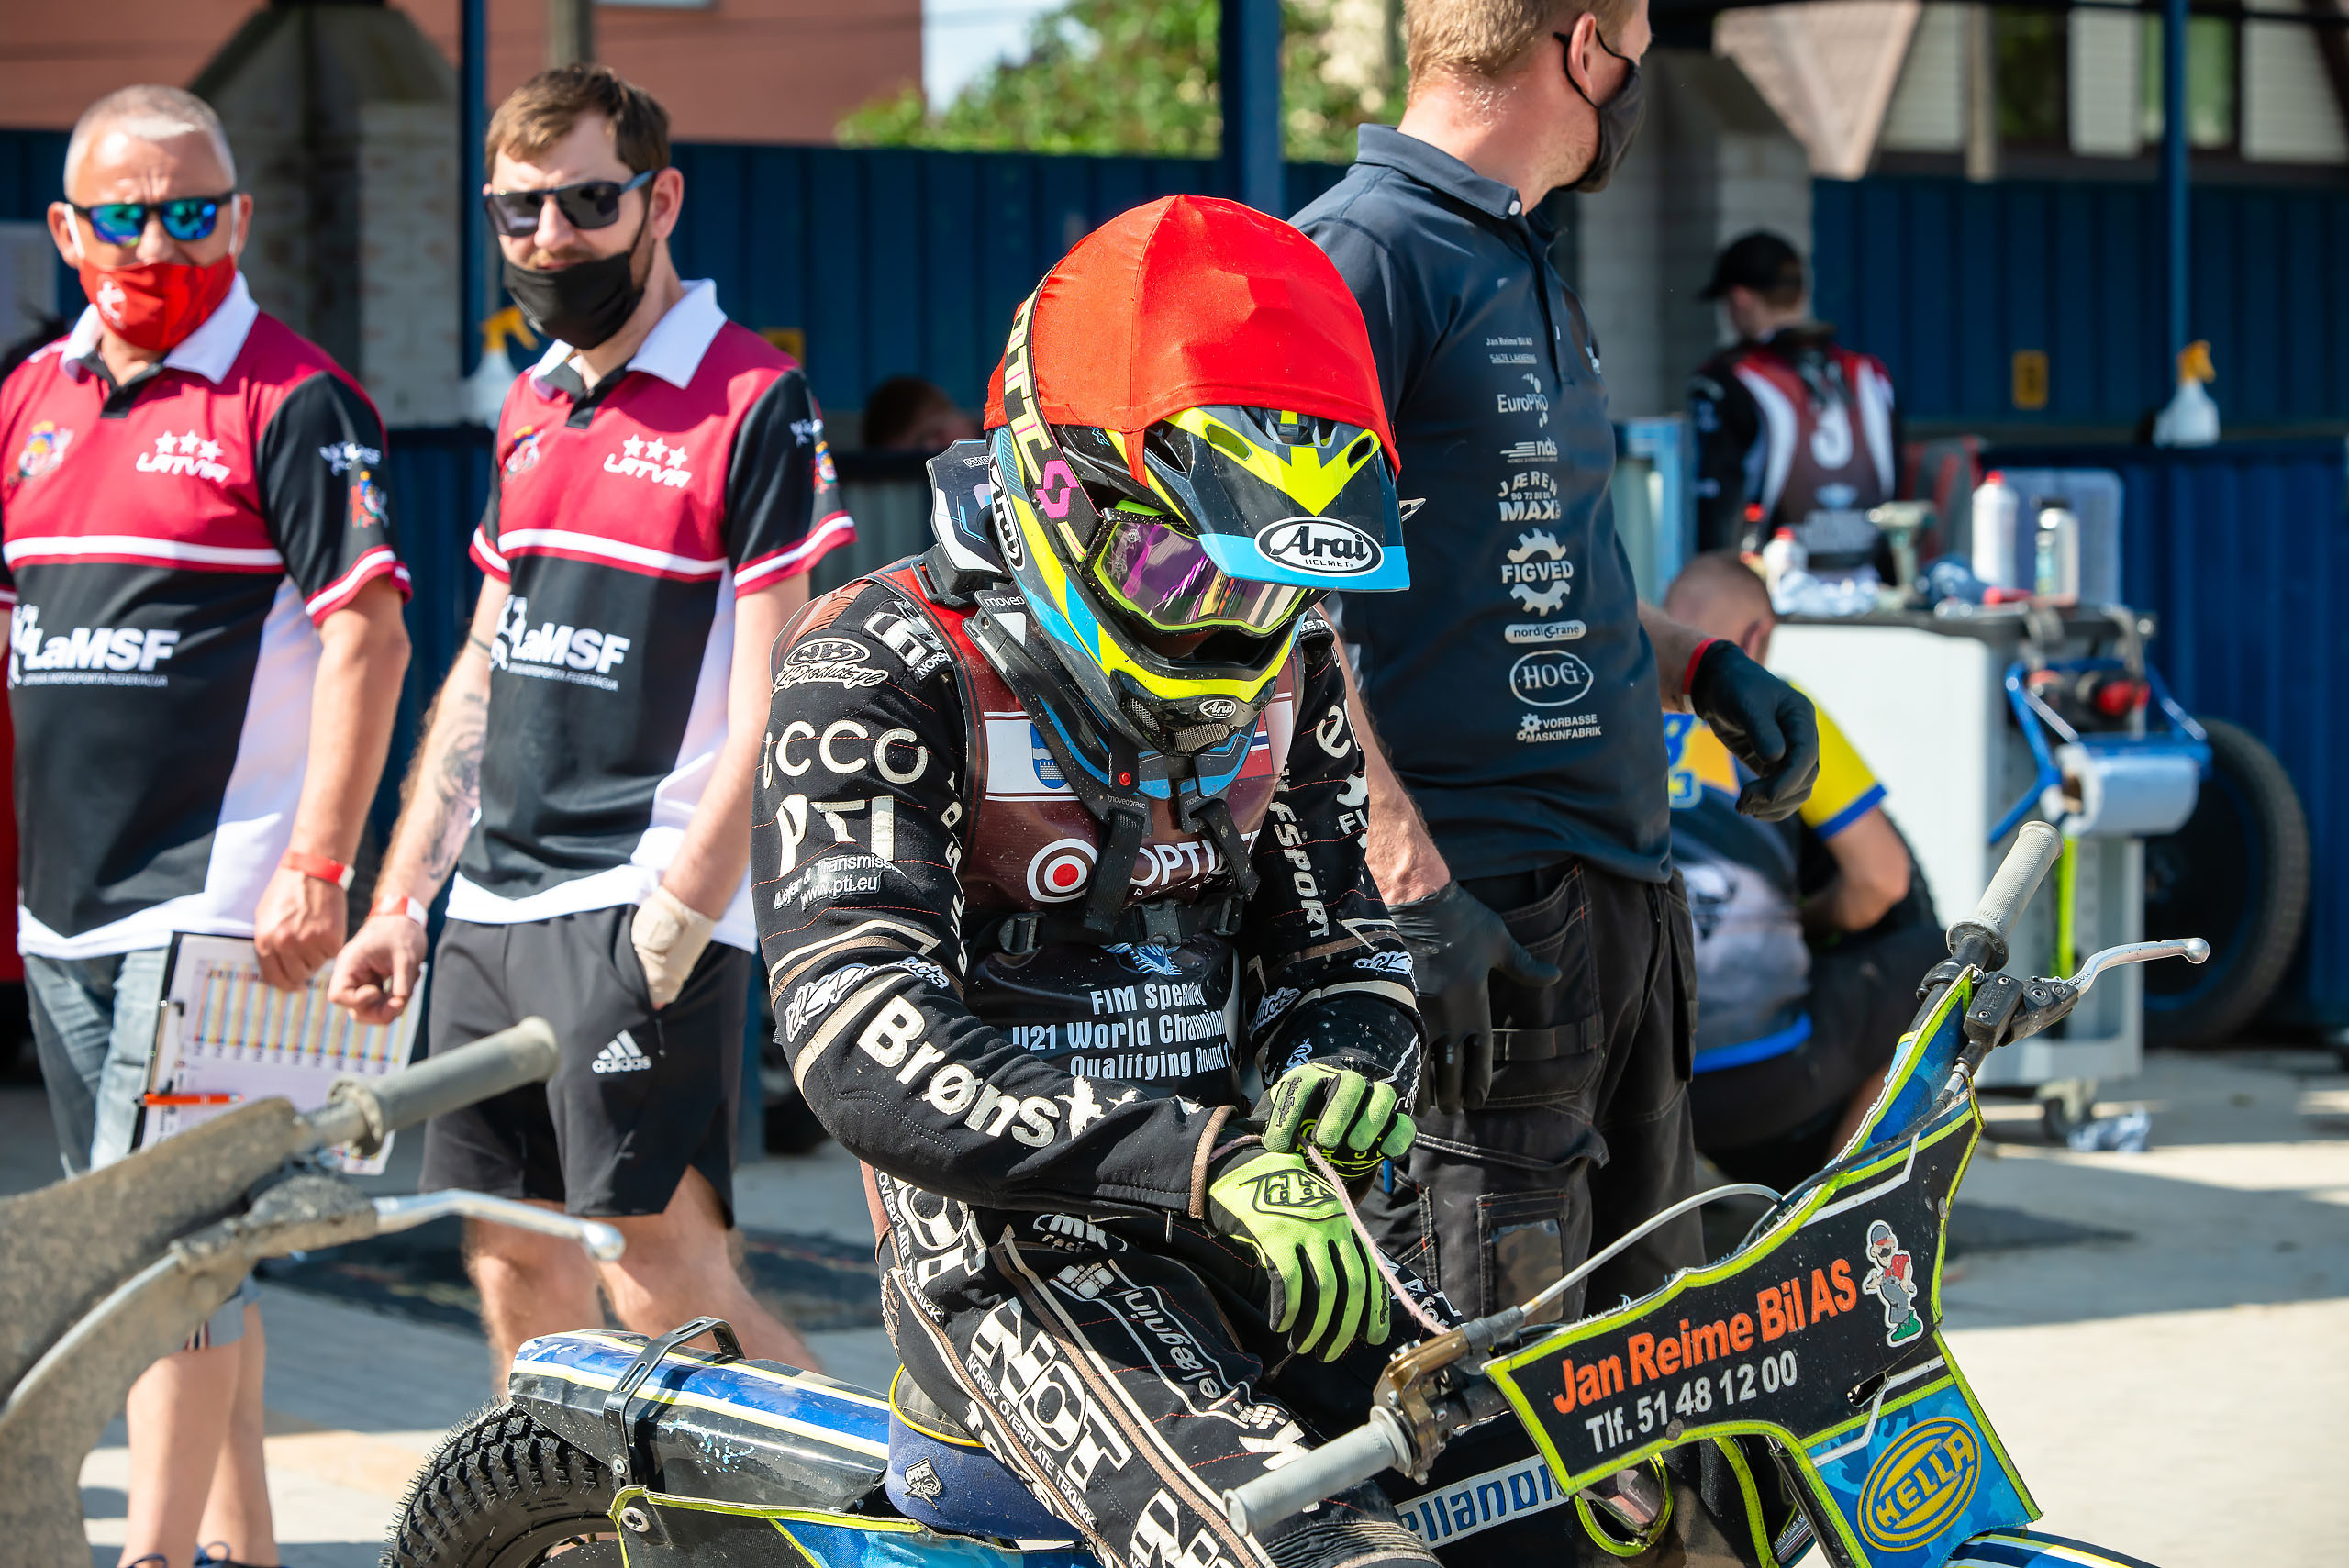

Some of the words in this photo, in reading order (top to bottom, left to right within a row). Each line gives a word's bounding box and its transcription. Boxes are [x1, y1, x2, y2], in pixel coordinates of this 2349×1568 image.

[603, 452, 692, 488] LATVIA
[1270, 525, 1368, 560] Arai
[1305, 558, 1350, 568] HELMET
[1501, 560, 1574, 584] FIGVED
[510, 622, 630, 674] LaMSF
[1522, 662, 1582, 689] HOG
[1197, 701, 1234, 713] Arai
[1542, 714, 1598, 729] VORBASSE
[1526, 726, 1602, 743] MASKINFABRIK
[776, 793, 894, 879] PTI
[800, 874, 878, 911] www.pti.eu
[1090, 985, 1137, 1015] FIM
[1145, 982, 1207, 1010] Speedway
[1012, 1024, 1056, 1051] U21
[1066, 1017, 1151, 1049] World
[1158, 1007, 1226, 1044] Champion
[858, 995, 1061, 1148] Brøns
[1071, 1051, 1191, 1081] Qualifying
[1196, 1043, 1222, 1073] Round
[1553, 1358, 1625, 1414] Jan
[1627, 1311, 1754, 1385] Reime
[1757, 1277, 1805, 1343] Bil
[1810, 1258, 1858, 1324] AS
[1585, 1409, 1633, 1455] Tlf.
[1636, 1387, 1669, 1435] 51
[1675, 1376, 1713, 1418] 48
[1719, 1362, 1757, 1407] 12
[1762, 1350, 1798, 1394] 00
[966, 1352, 998, 1407] NORSK
[998, 1397, 1055, 1481] OVERFLATE
[1055, 1469, 1099, 1535] TEKNIKK
[1876, 1429, 1975, 1528] HELLA
